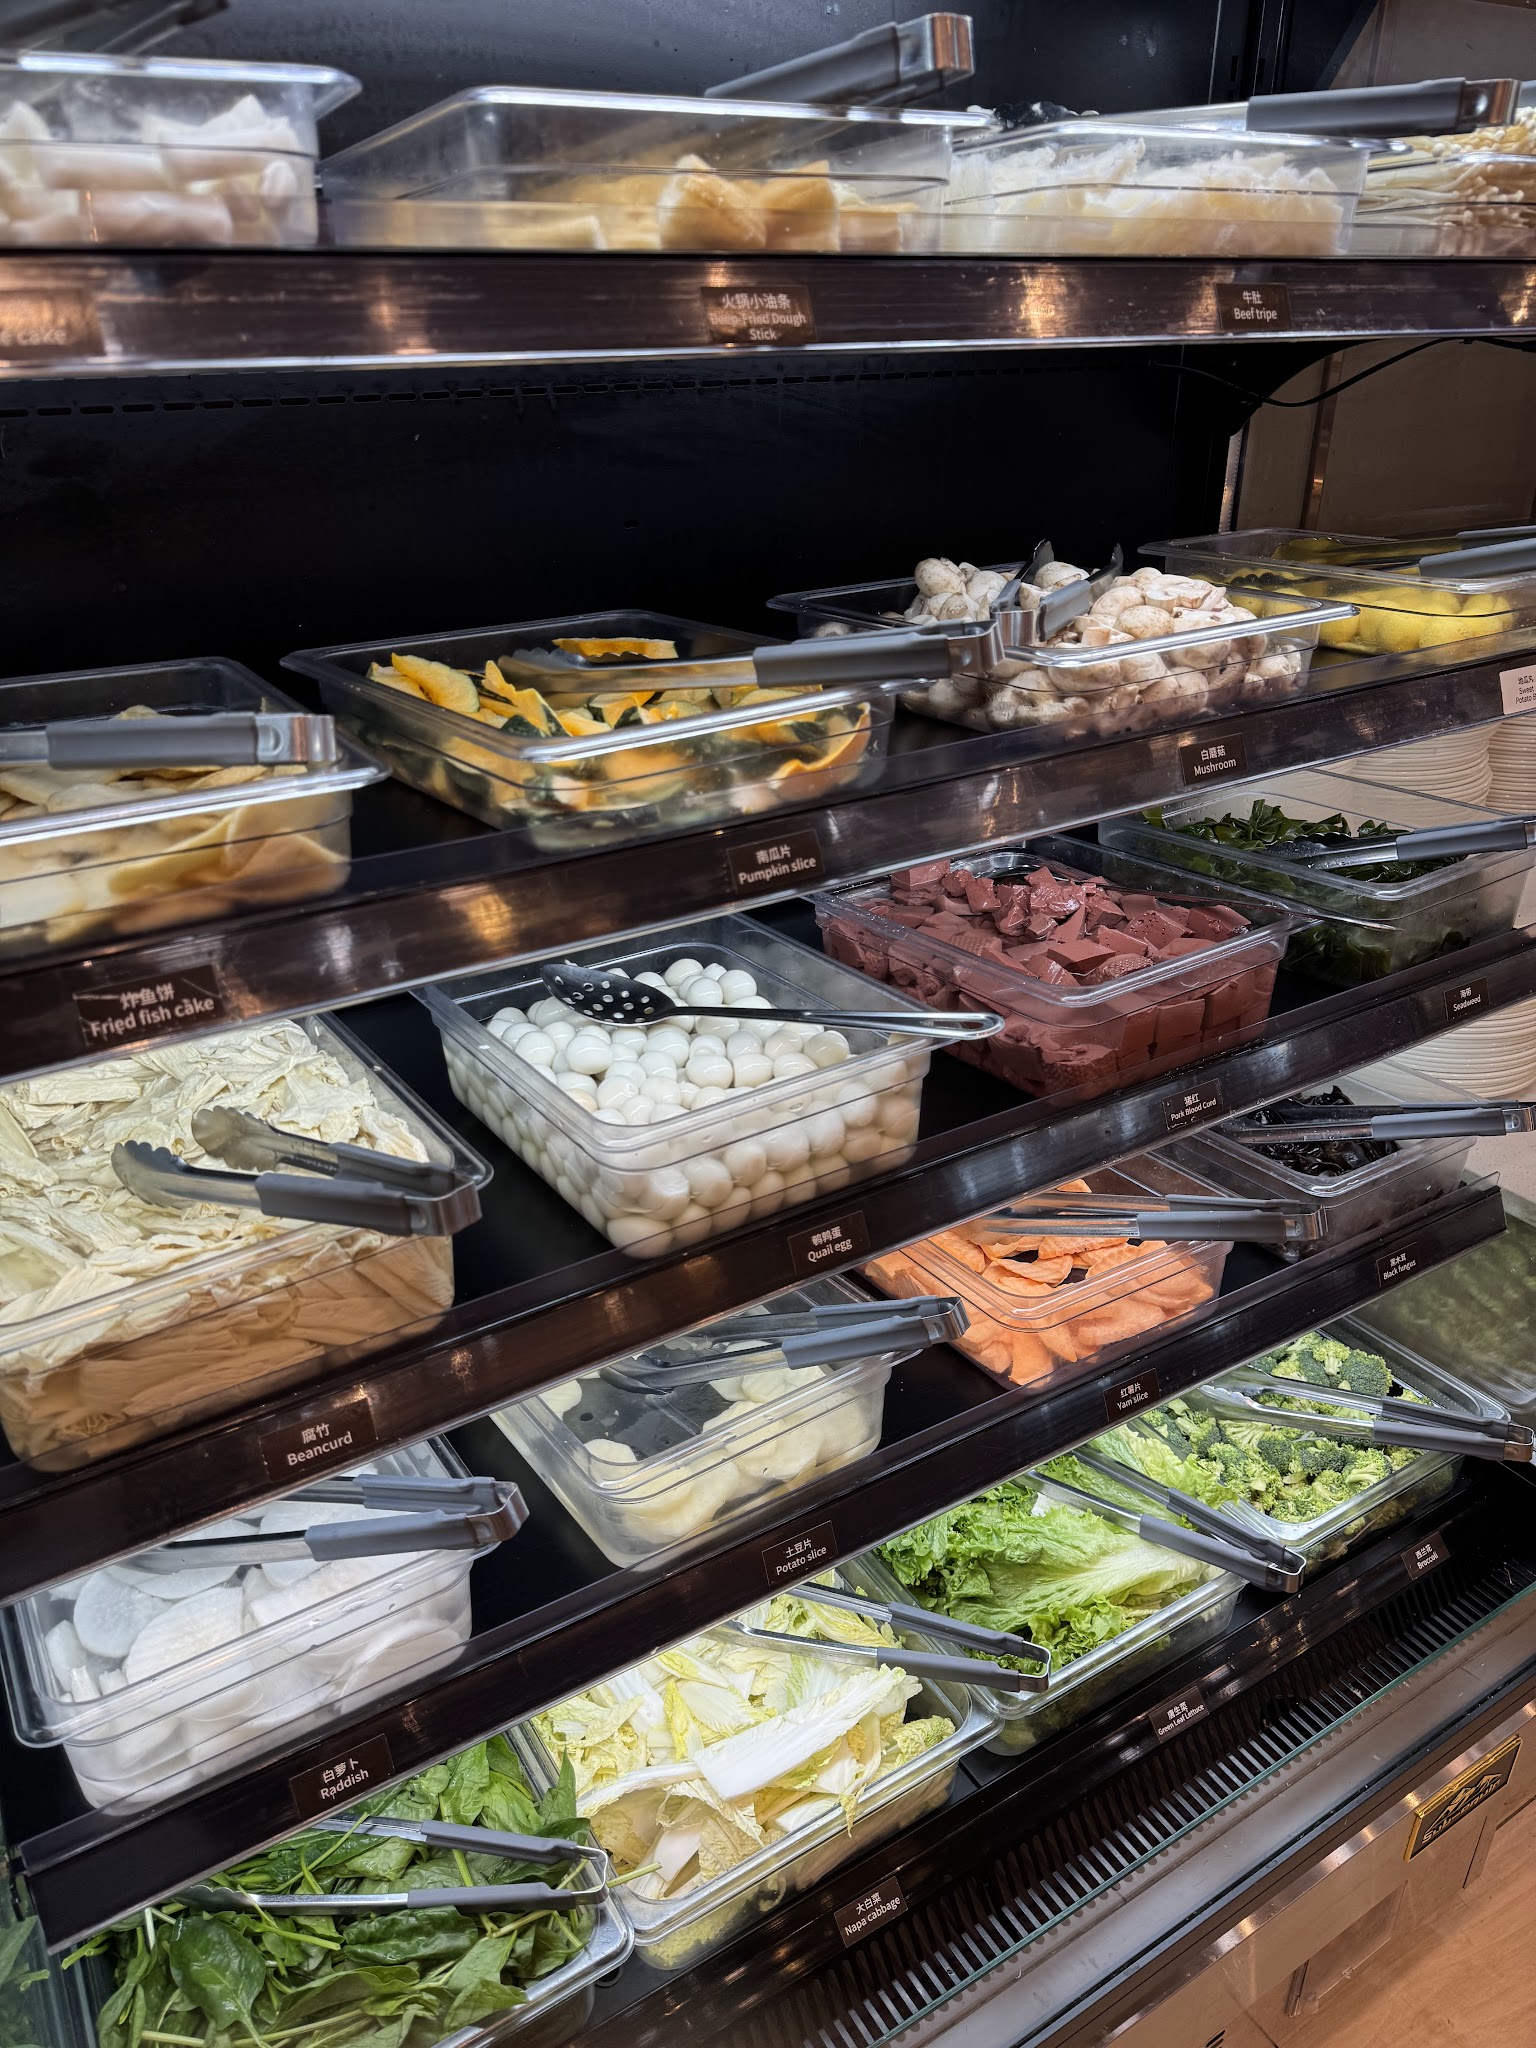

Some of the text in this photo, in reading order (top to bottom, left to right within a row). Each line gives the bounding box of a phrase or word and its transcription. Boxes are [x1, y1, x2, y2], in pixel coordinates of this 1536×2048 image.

[1242, 290, 1263, 305] 牛肚
[771, 311, 806, 328] Dough
[1233, 307, 1278, 323] Beef tripe
[749, 328, 777, 341] Stick
[1515, 694, 1533, 705] Potato
[1200, 744, 1226, 761] 白蘑菇
[1193, 758, 1237, 777] Mushroom
[755, 844, 792, 865] 南瓜片
[738, 857, 817, 885] Pumpkin slice
[119, 982, 175, 1011] 炸鱼饼
[90, 997, 215, 1037] Fried fish cake
[1170, 1109, 1186, 1121] Pork
[1185, 1102, 1203, 1116] Blood
[811, 1225, 843, 1247] 鹌鹑蛋
[807, 1238, 853, 1263] Quail egg
[1383, 1259, 1417, 1280] Black fungus
[1116, 1391, 1149, 1411] Yam slice
[301, 1422, 330, 1444] 腐竹
[287, 1430, 354, 1466] Beancurd
[785, 1538, 812, 1559] 土豆片
[776, 1546, 827, 1576] Potato slice
[1416, 1550, 1439, 1570] Broccoli
[1157, 1704, 1205, 1736] Green Leaf Lettuce
[322, 1758, 359, 1784] 白萝卜
[320, 1768, 370, 1800] Raddish
[855, 1891, 882, 1916] 大白菜
[844, 1896, 901, 1937] Napa cabbage
